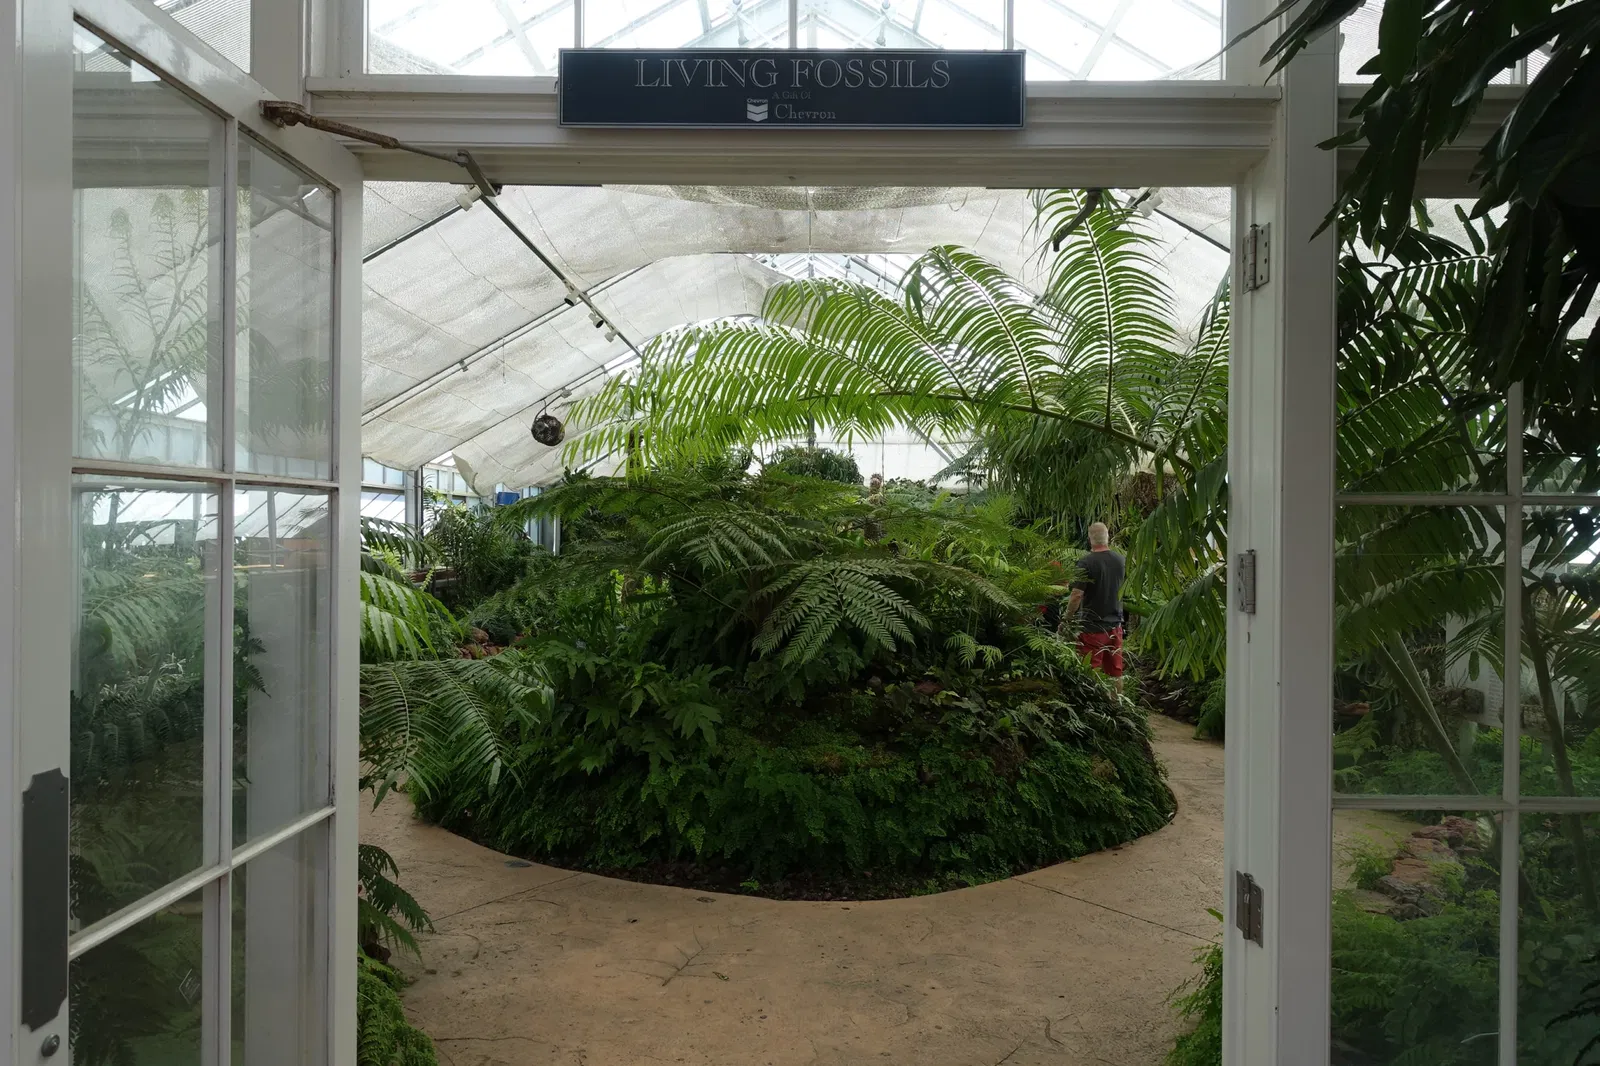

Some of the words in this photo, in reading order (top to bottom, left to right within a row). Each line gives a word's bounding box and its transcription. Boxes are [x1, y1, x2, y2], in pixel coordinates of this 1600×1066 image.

[634, 58, 779, 88] LIVING
[789, 58, 951, 88] FOSSILS
[772, 91, 780, 100] A
[782, 91, 798, 100] Gift
[775, 103, 837, 119] Chevron
